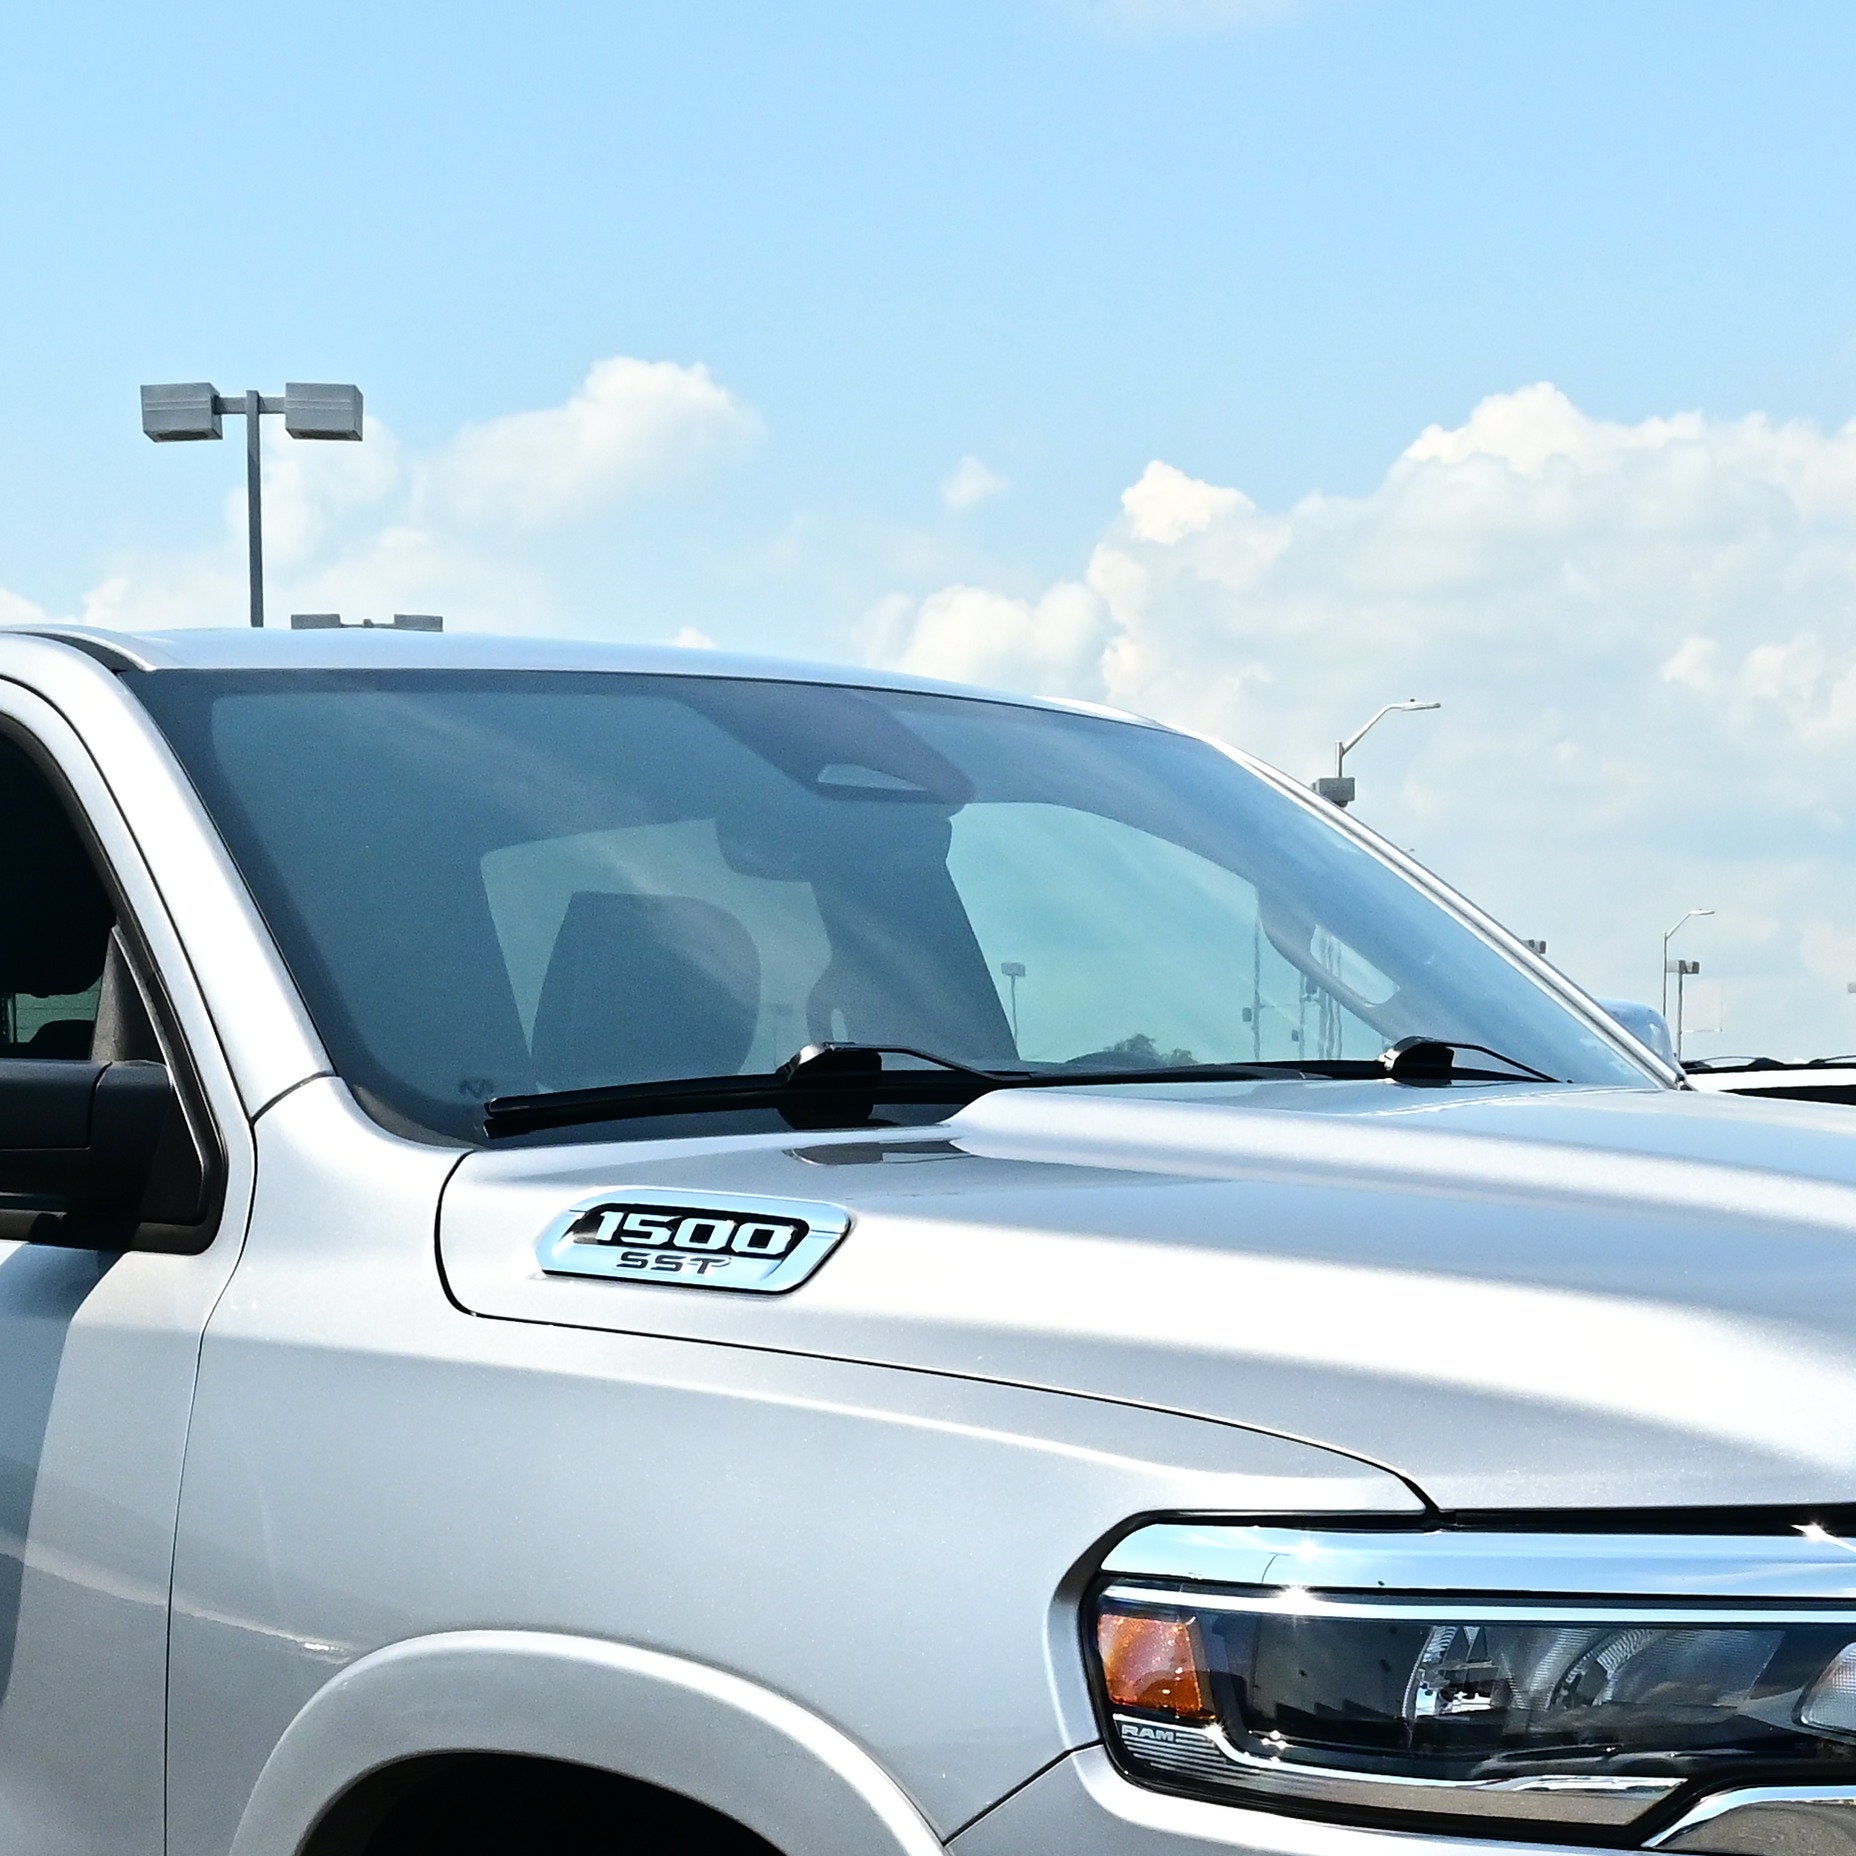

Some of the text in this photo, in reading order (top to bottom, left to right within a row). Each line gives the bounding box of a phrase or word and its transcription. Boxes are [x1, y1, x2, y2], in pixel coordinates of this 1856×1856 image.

[594, 1210, 796, 1256] 1500
[615, 1251, 732, 1276] SST
[1121, 1724, 1175, 1742] RAM
